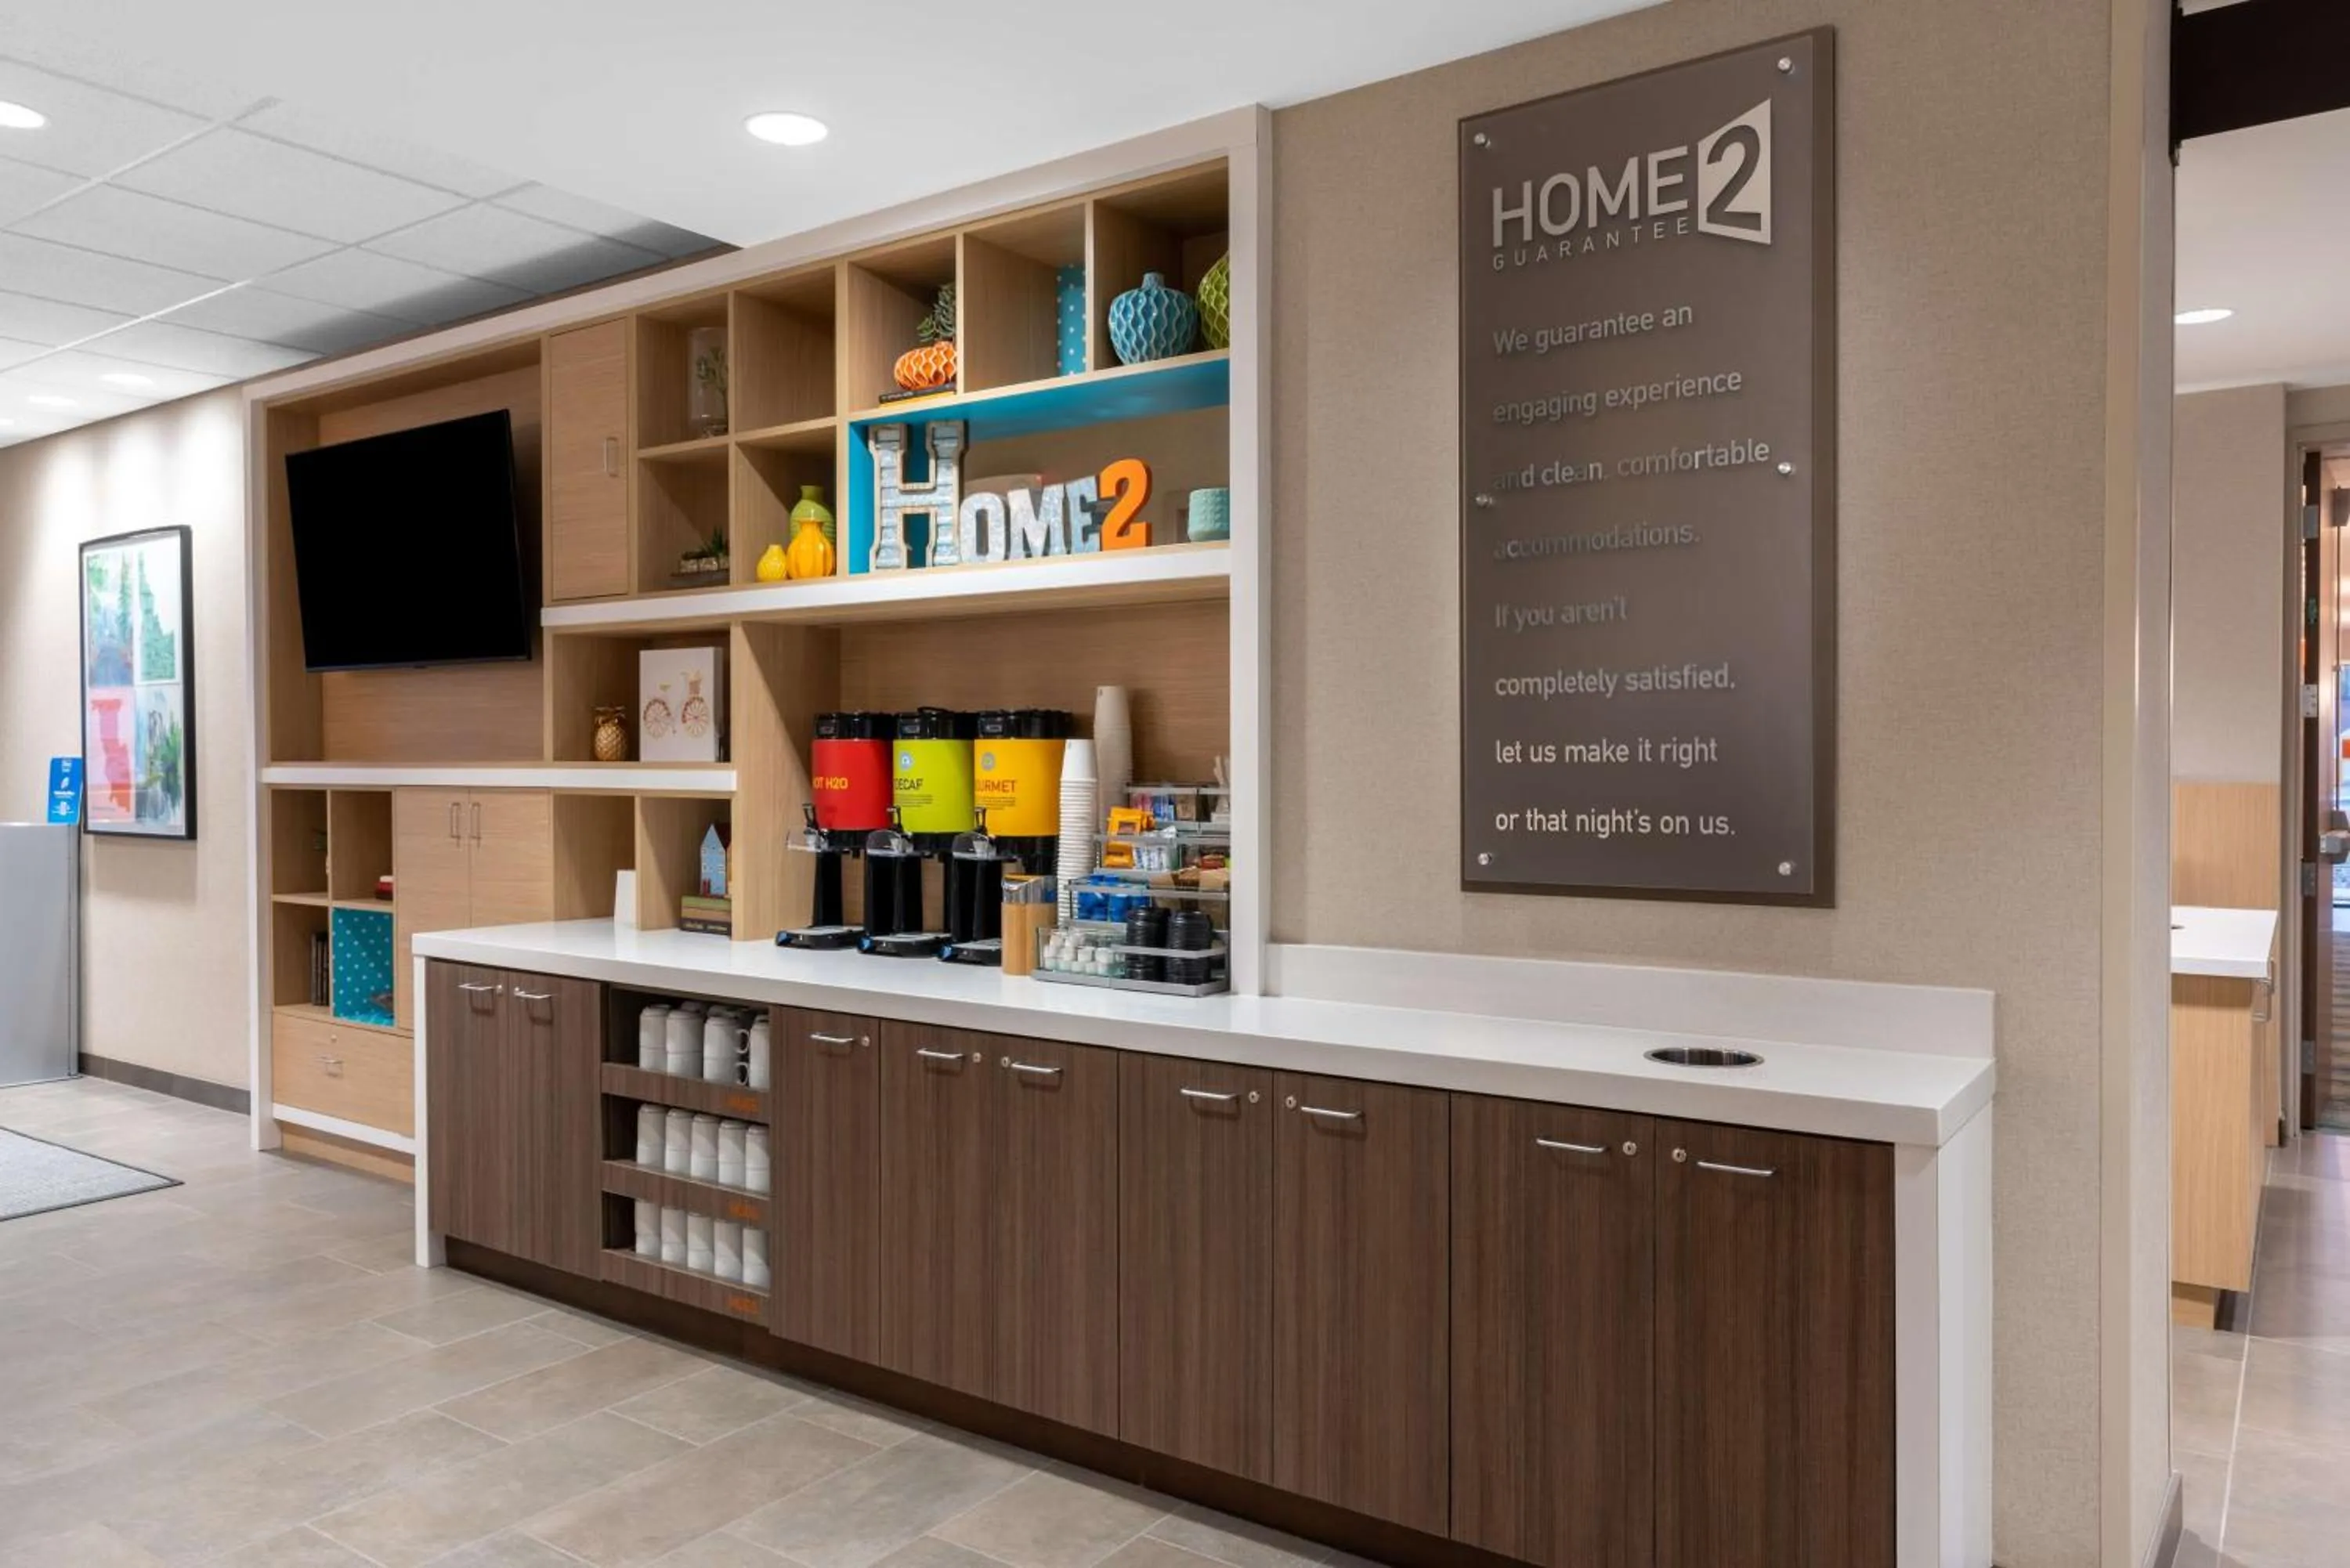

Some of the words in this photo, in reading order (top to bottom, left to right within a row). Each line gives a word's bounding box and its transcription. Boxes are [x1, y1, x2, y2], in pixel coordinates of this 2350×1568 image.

[1493, 217, 1689, 271] GUARANTEE
[1493, 328, 1528, 355] We
[1535, 310, 1654, 355] guarantee
[1661, 305, 1693, 327] an
[1493, 392, 1597, 425] engaging
[1605, 370, 1742, 410] experience
[1617, 438, 1770, 476] comfortable
[1495, 602, 1509, 627] If
[1514, 604, 1554, 634] you
[1560, 595, 1627, 624] aren't
[1495, 667, 1619, 701] completely
[1625, 663, 1736, 692] satisfied.
[1495, 739, 1522, 764] let
[1530, 744, 1557, 763] us
[1564, 739, 1630, 764] make
[1638, 737, 1653, 763] it
[1660, 736, 1718, 768] right
[1495, 812, 1520, 832] or
[1526, 807, 1568, 833] that
[1575, 807, 1651, 838] night's
[1659, 816, 1690, 834] on
[1698, 816, 1737, 836] us.
